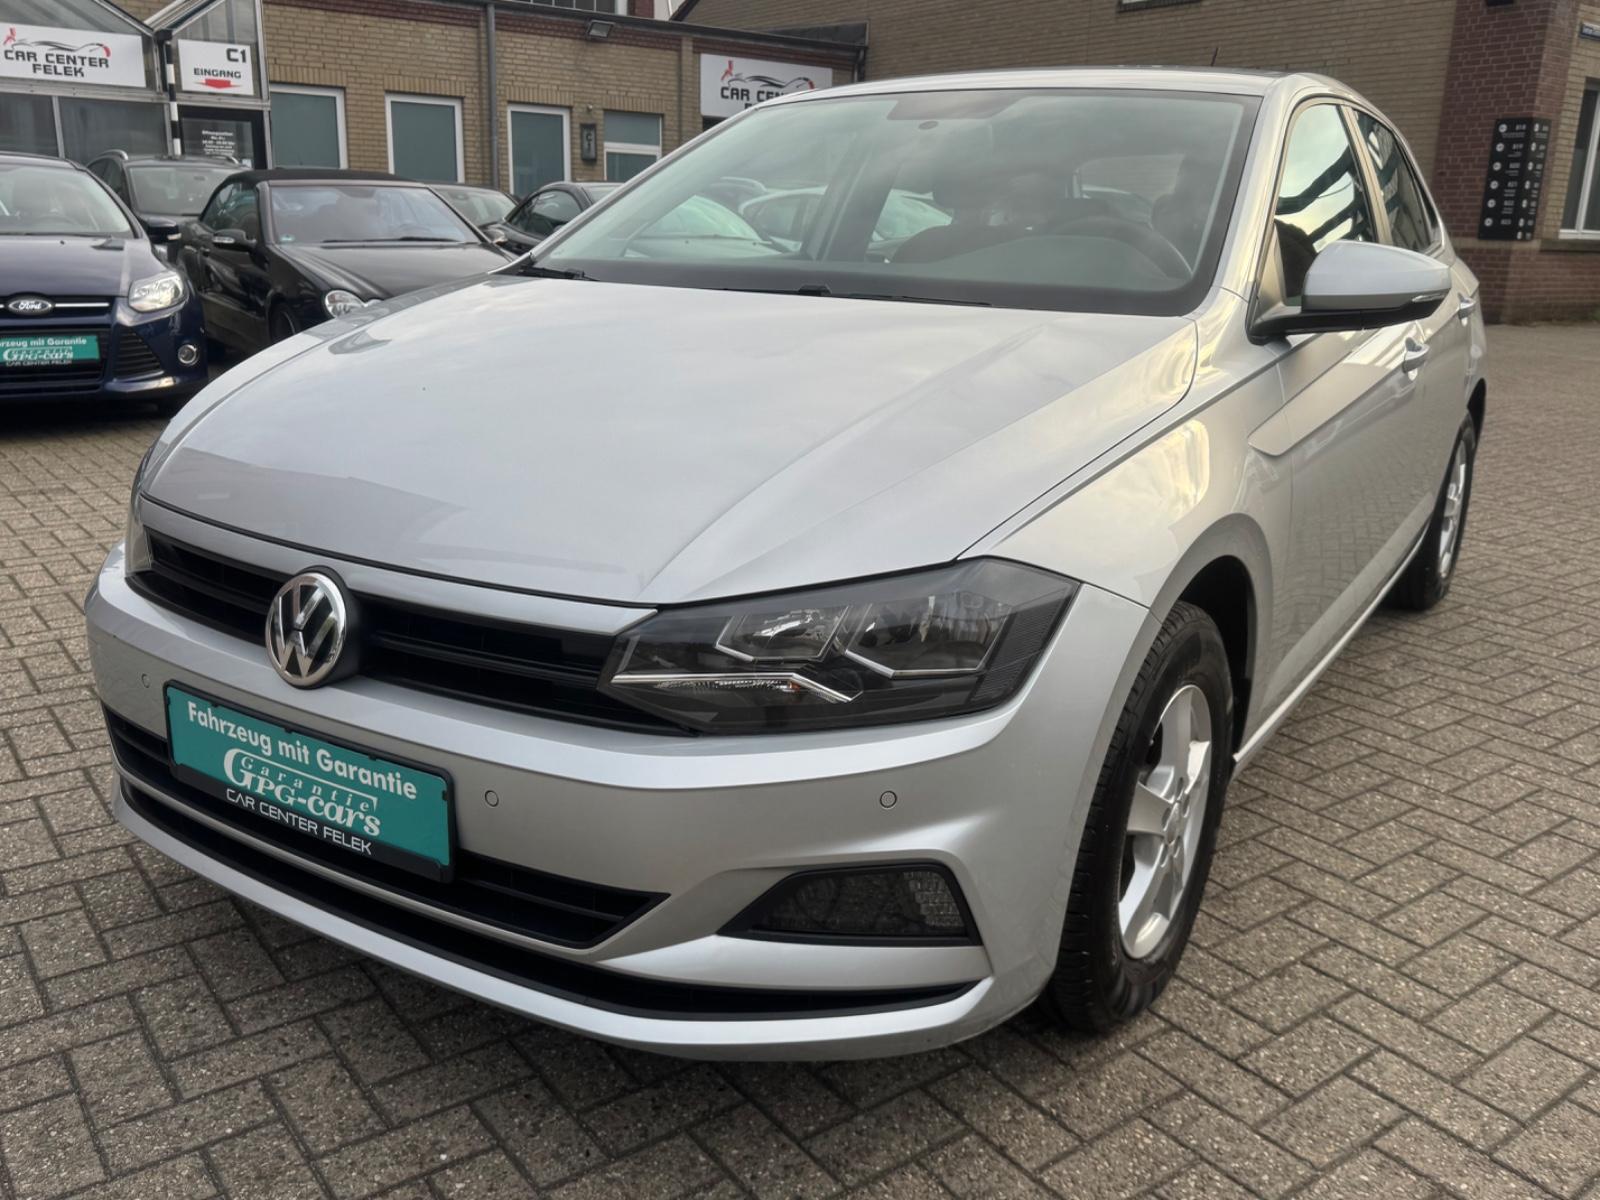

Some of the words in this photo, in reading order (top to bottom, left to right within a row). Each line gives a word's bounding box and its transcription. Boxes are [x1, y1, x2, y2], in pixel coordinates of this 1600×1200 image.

[4, 49, 38, 62] CAR
[45, 53, 110, 69] CENTER
[226, 47, 247, 63] C1
[32, 63, 85, 77] FELEK
[193, 67, 242, 79] EINGANG
[720, 86, 750, 101] CAR
[18, 300, 42, 310] Ford
[0, 339, 28, 348] rzeug
[30, 337, 45, 346] mit
[187, 701, 272, 757] Fahrzeug
[278, 739, 310, 765] mit
[316, 748, 418, 800] Garantie
[223, 747, 381, 837] GPG-cars
[226, 788, 255, 811] CAR
[259, 801, 319, 836] CENTER
[323, 825, 372, 856] FELEK
